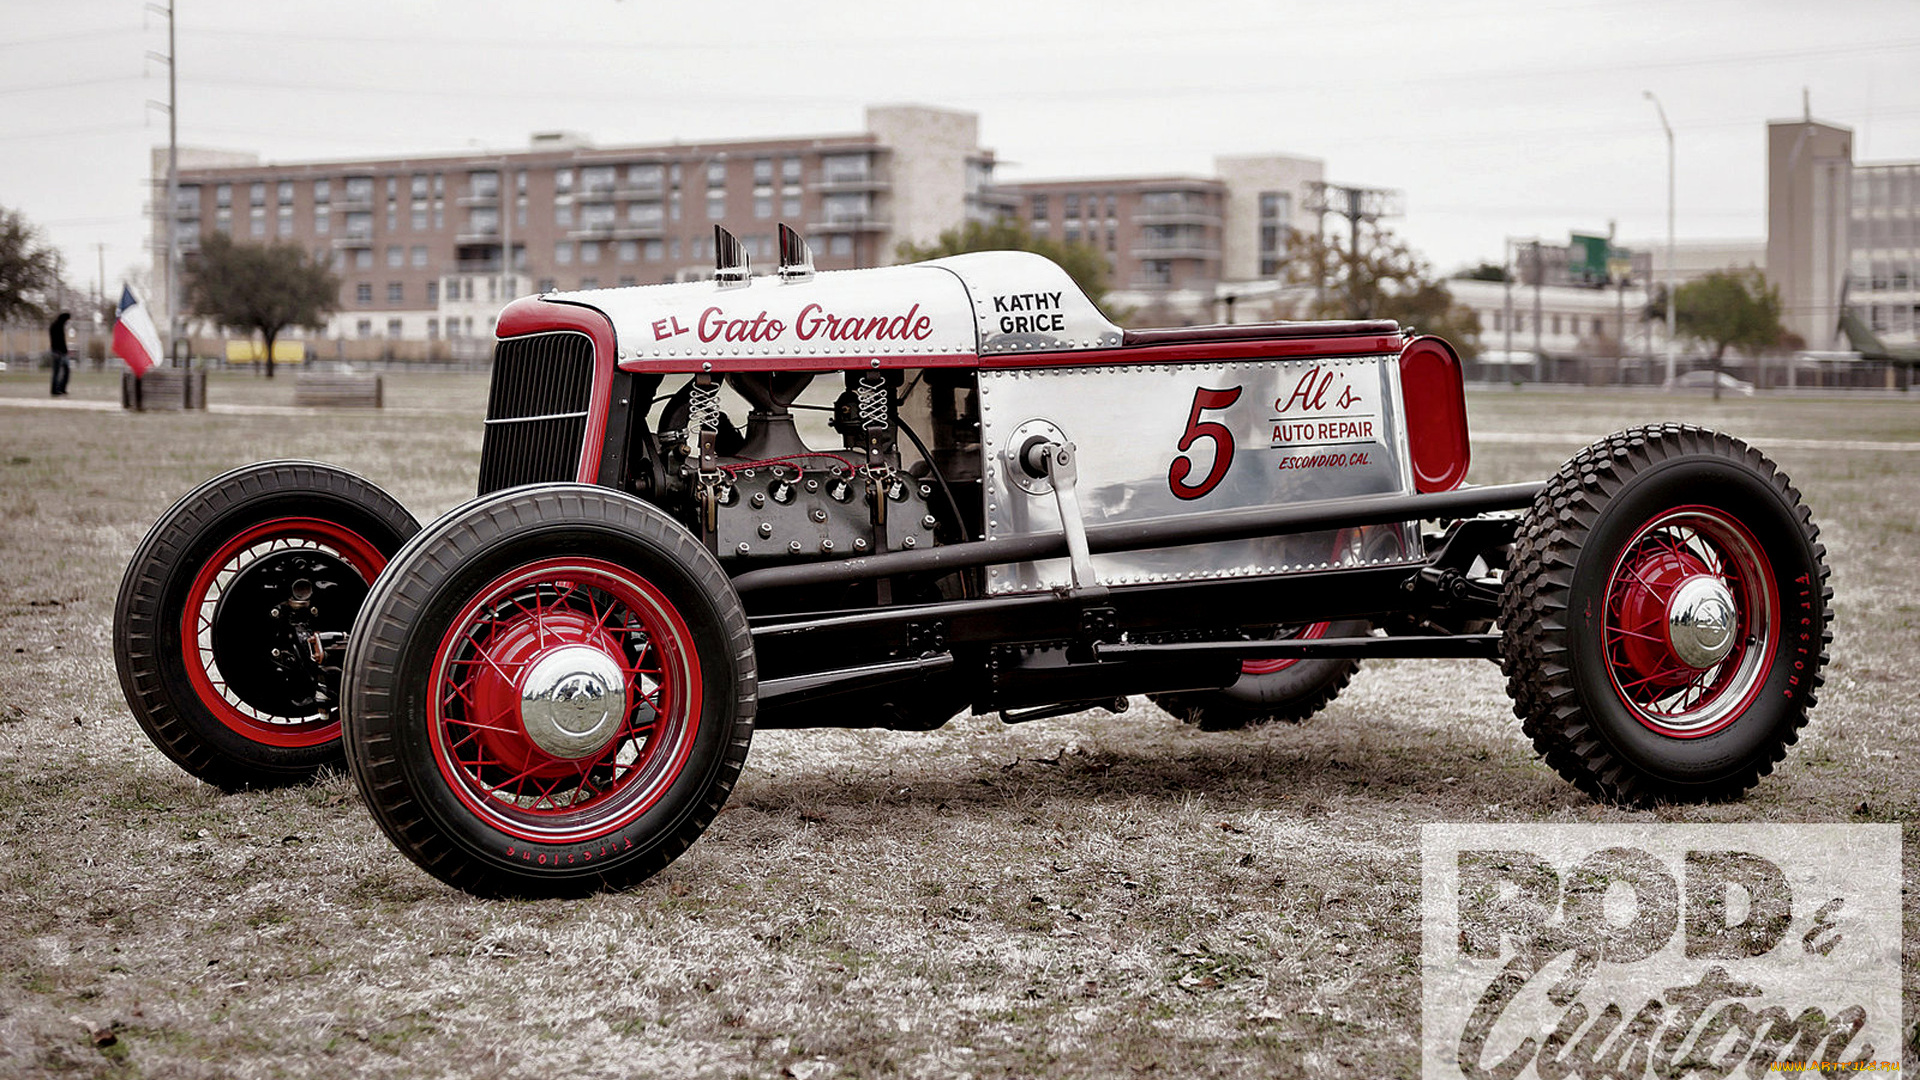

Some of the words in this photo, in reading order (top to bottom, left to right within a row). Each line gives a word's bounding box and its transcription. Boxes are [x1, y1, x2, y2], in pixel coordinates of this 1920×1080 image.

[994, 291, 1063, 312] KATHY
[652, 317, 689, 342] EL
[697, 306, 787, 343] Gato
[795, 303, 933, 342] Grande
[1000, 312, 1065, 334] GRICE
[1275, 365, 1362, 413] Al's
[1168, 385, 1243, 501] 5
[1272, 423, 1315, 442] AUTO
[1318, 421, 1373, 440] REPAIR
[1784, 573, 1811, 698] Firestone
[505, 836, 633, 865] Firestone
